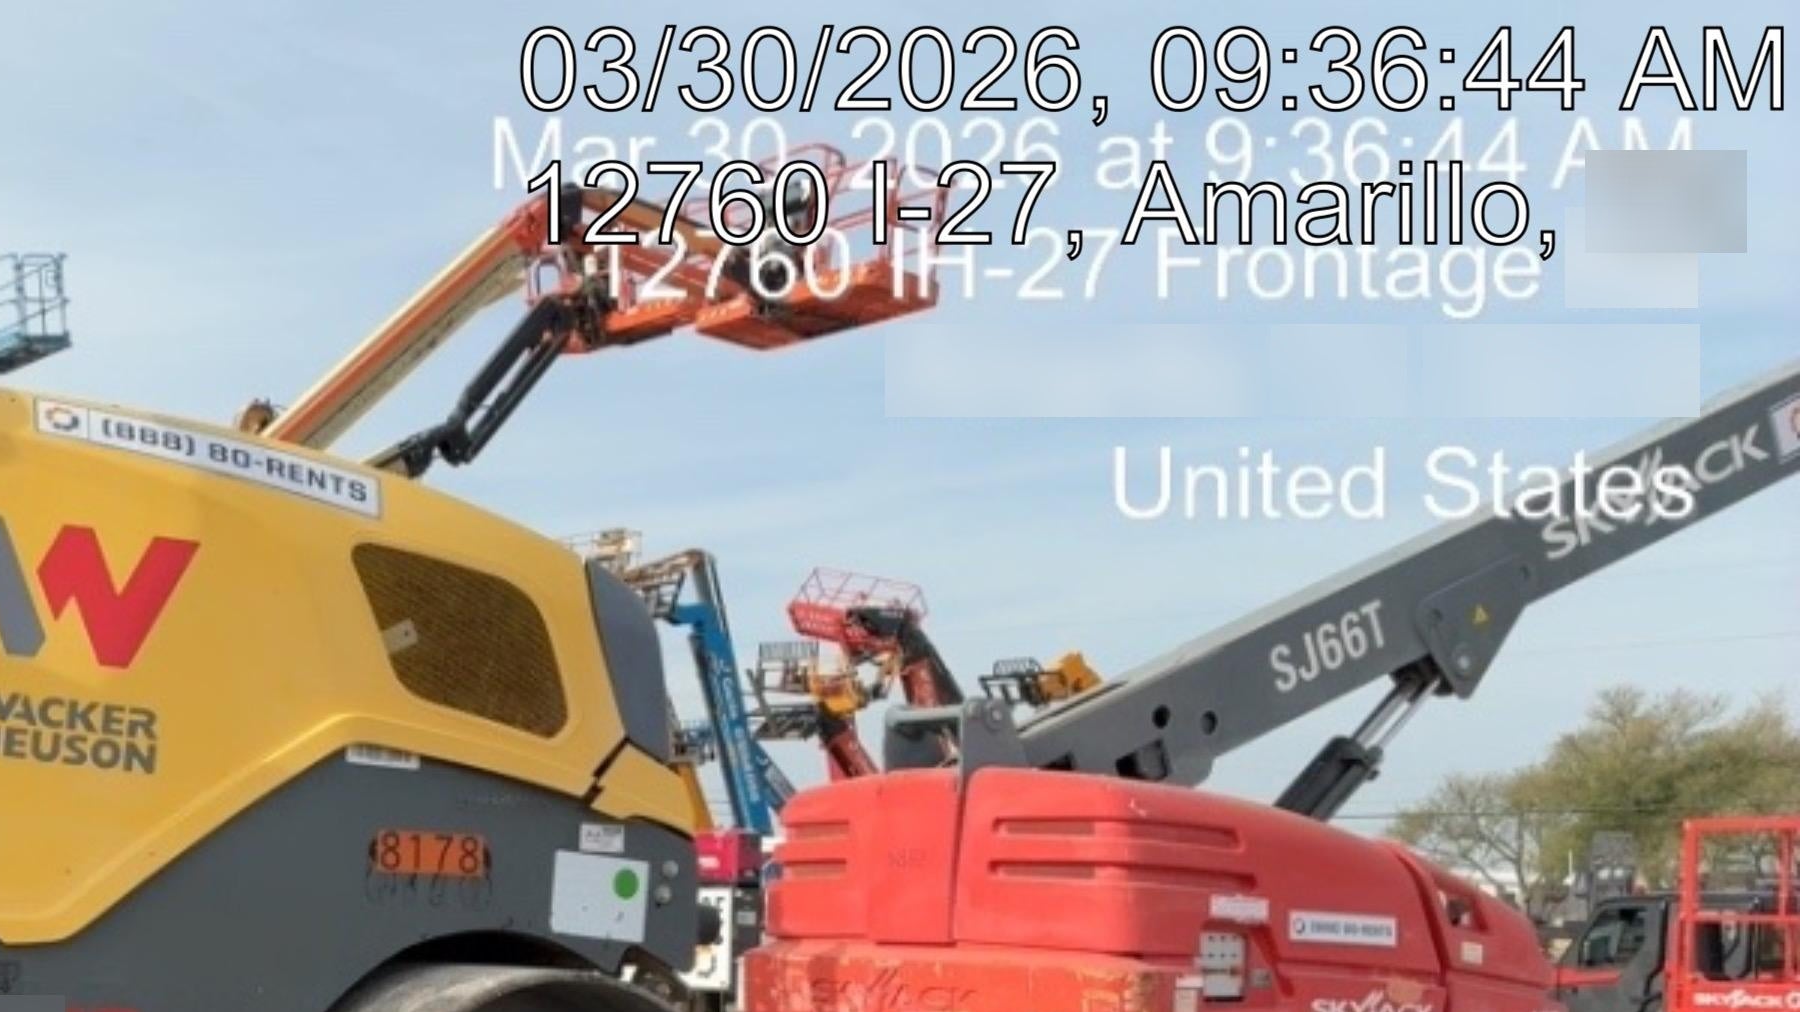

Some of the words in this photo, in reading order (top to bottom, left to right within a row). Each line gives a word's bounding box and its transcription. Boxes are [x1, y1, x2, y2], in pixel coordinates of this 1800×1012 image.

[101, 418, 196, 456] (888)
[1270, 598, 1385, 693] SJ66T
[379, 831, 482, 874] 8178
